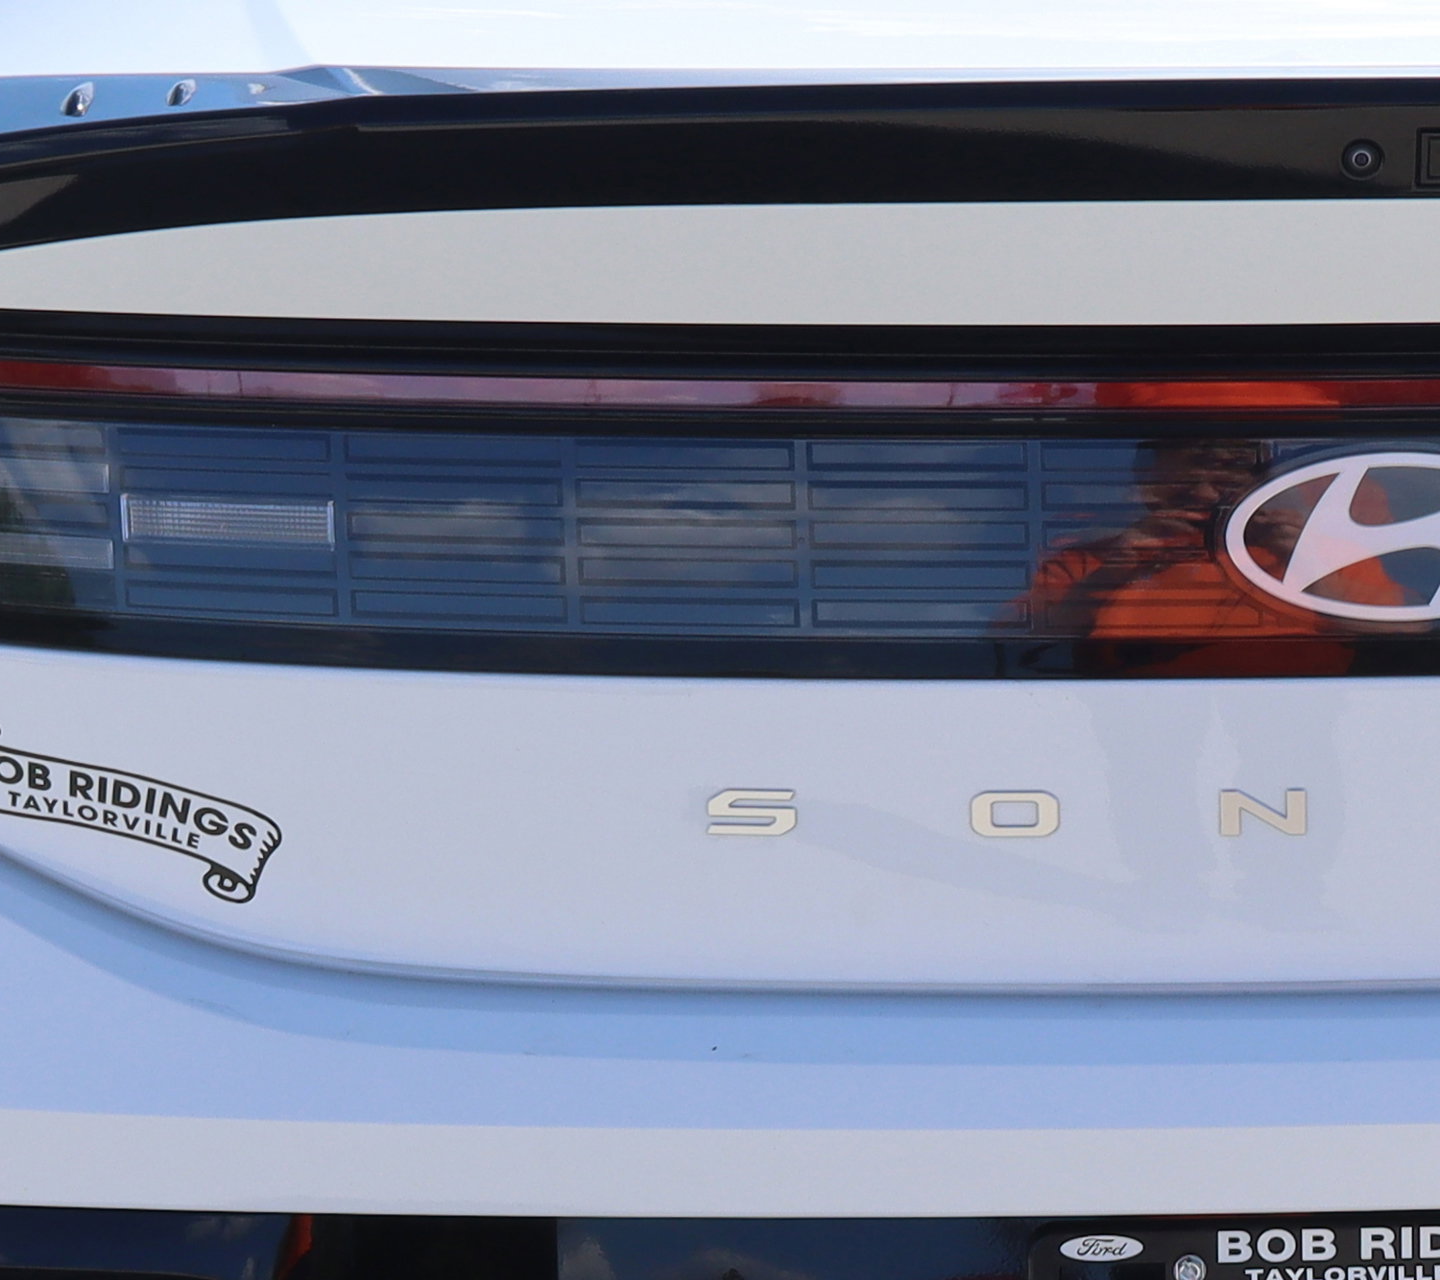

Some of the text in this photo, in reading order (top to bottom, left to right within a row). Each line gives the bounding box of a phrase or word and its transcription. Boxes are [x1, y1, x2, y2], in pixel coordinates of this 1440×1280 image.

[8, 790, 201, 850] TAYLORVILLE
[68, 769, 257, 851] RIDINGS
[1217, 1229, 1337, 1265] BOB
